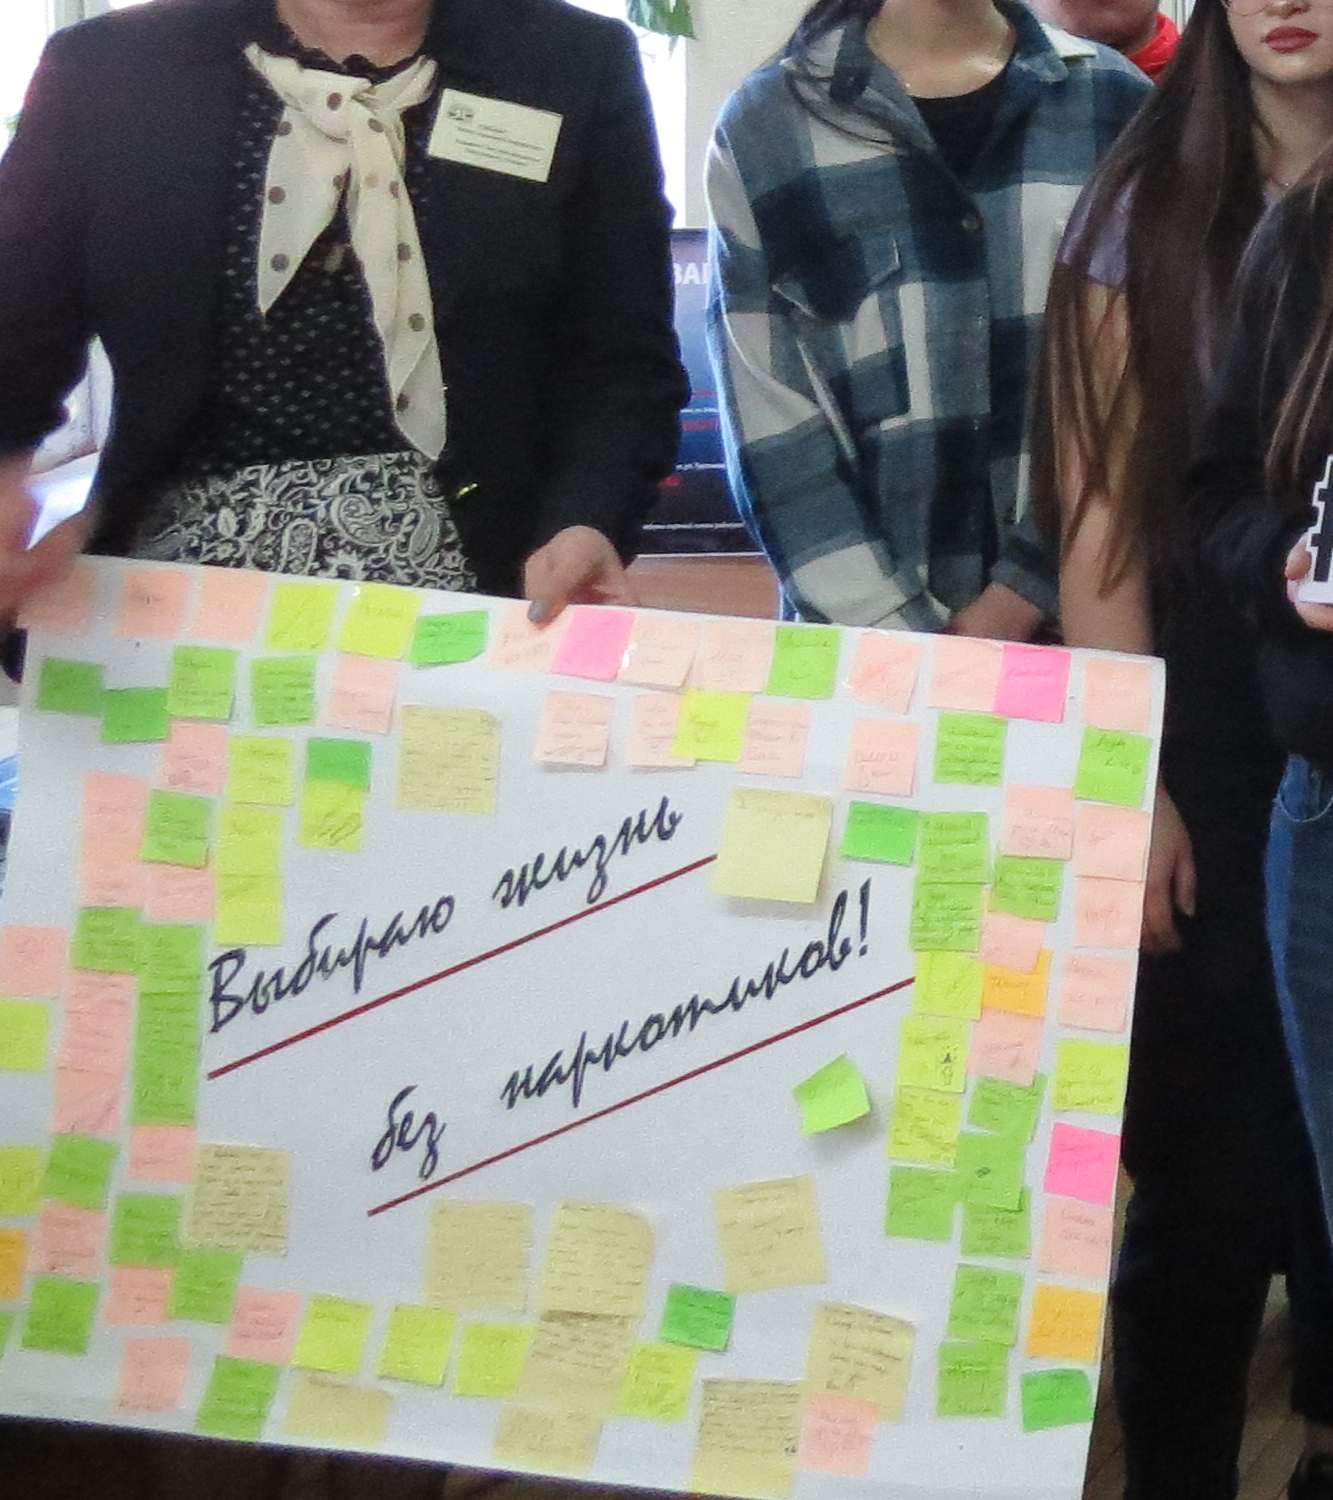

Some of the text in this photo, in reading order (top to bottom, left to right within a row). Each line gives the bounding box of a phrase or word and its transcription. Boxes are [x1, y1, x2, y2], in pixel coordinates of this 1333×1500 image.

[207, 795, 683, 1035] Выбираю жизнь
[371, 878, 872, 1181] без наркотиков!
